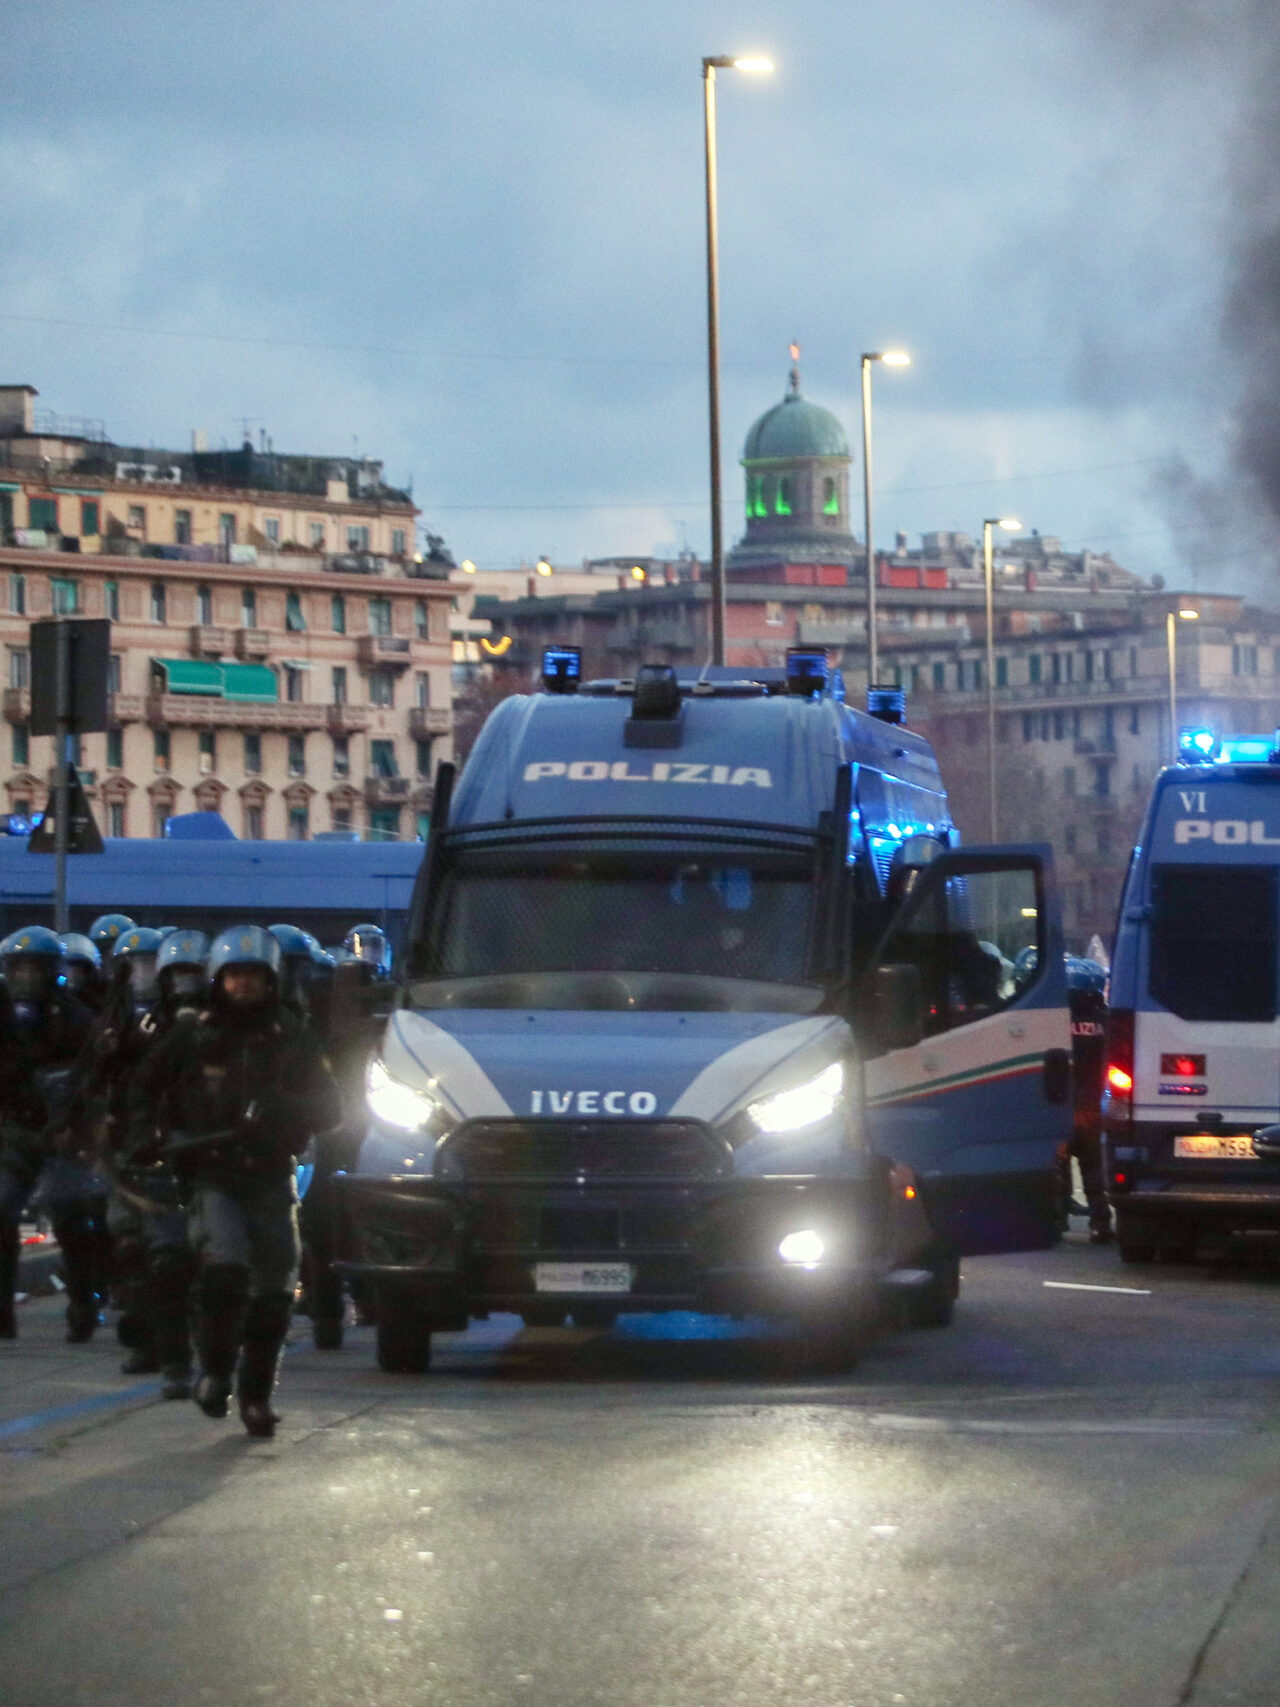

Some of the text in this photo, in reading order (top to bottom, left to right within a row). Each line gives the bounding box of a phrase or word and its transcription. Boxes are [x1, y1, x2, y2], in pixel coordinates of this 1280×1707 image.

[523, 761, 774, 788] POLIZIA
[1178, 791, 1208, 813] VI
[531, 1090, 657, 1114] IVECO
